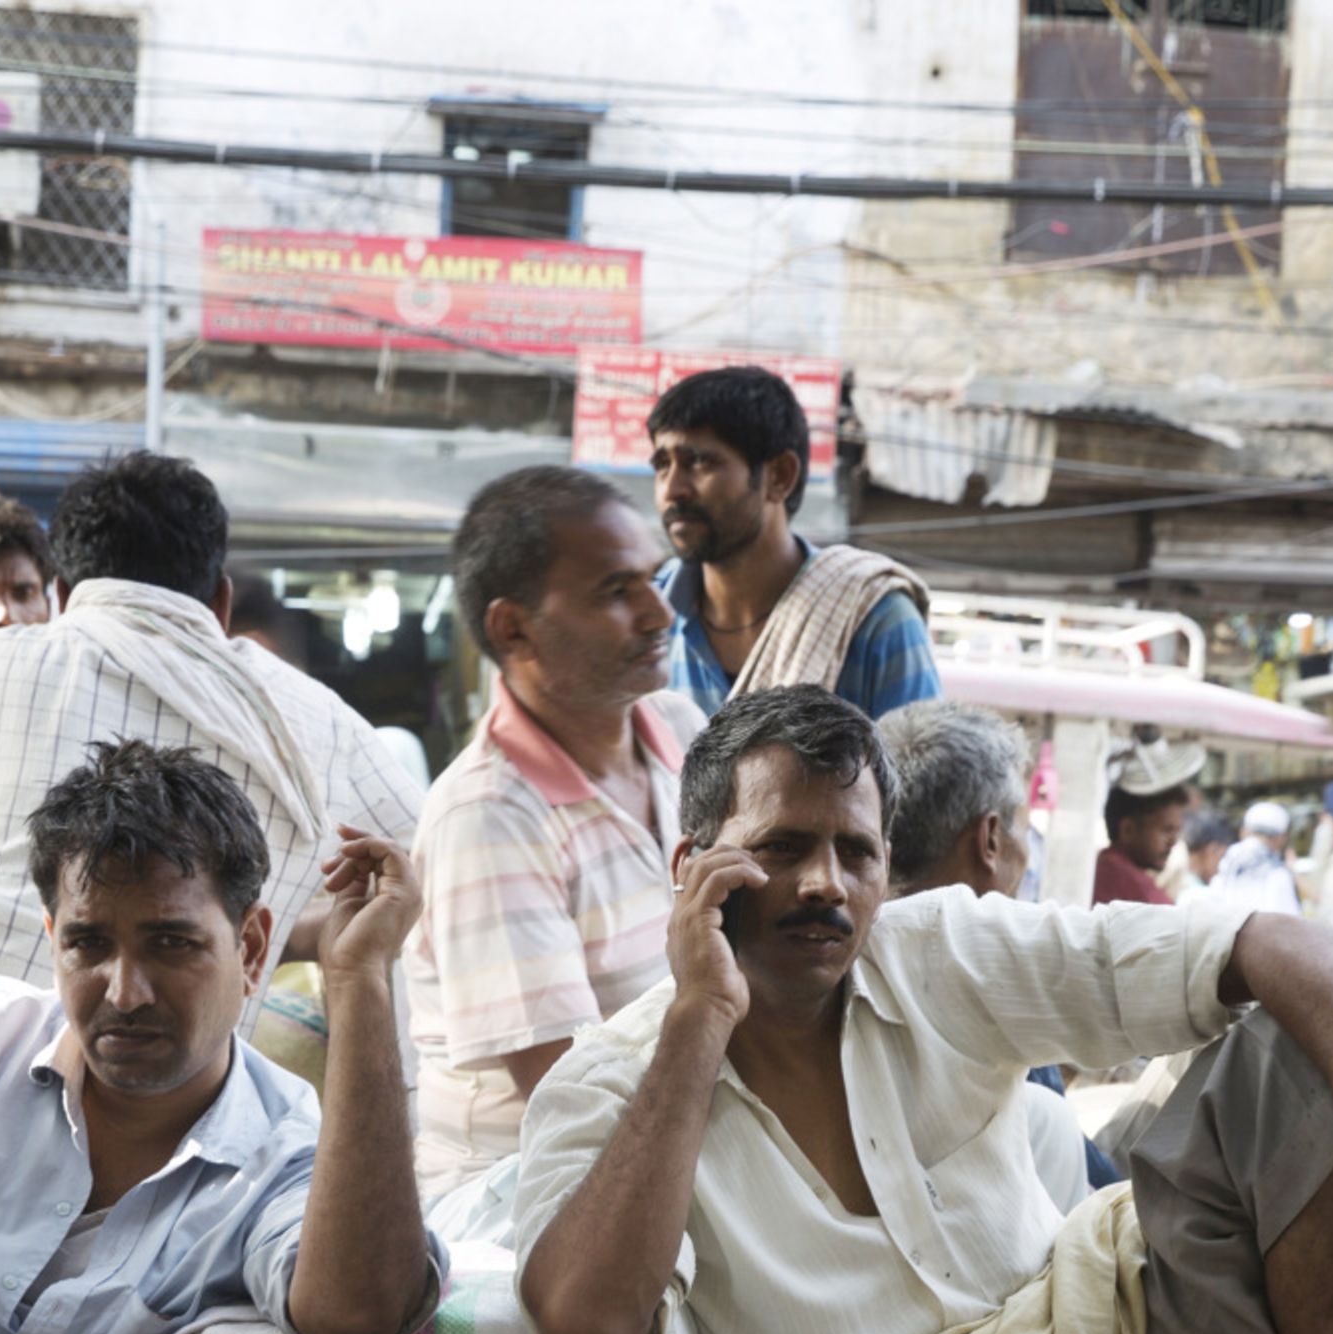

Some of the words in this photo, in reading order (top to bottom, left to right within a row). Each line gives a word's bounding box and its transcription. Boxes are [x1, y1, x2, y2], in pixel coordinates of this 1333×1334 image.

[218, 244, 342, 274] SHANTI
[349, 250, 411, 278] LAL
[419, 254, 502, 284] AMIT
[509, 260, 629, 289] KUMAR
